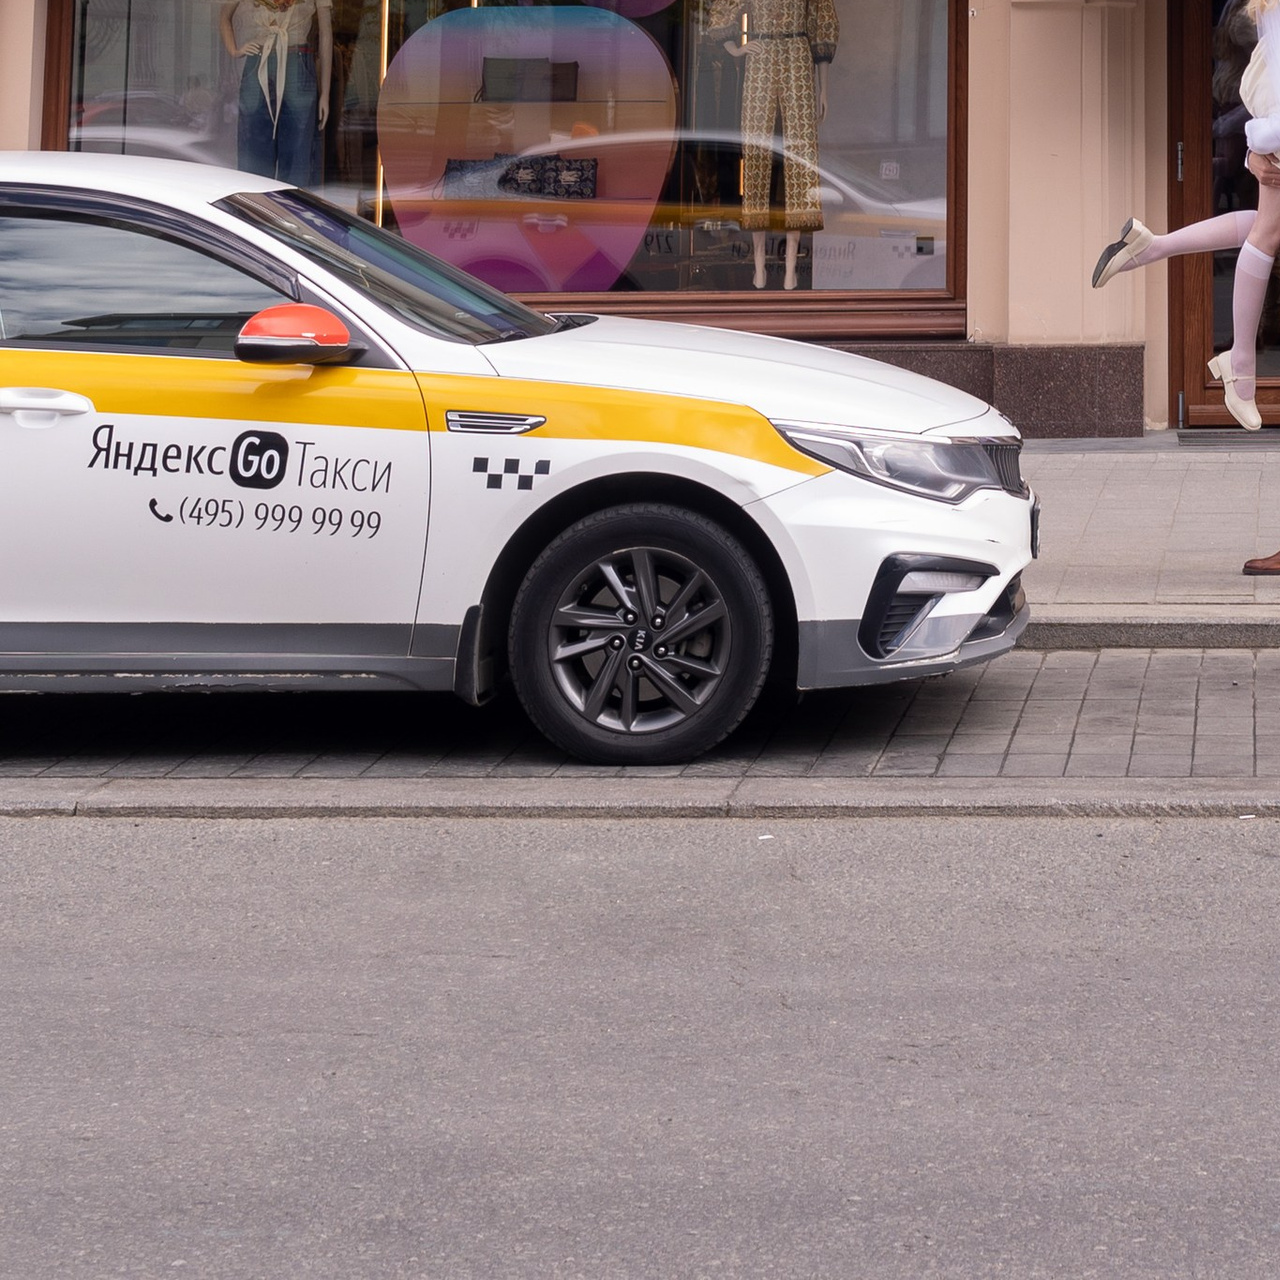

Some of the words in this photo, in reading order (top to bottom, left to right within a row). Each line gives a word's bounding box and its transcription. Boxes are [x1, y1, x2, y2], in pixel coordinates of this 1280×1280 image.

[87, 424, 227, 477] Яндекс
[236, 436, 281, 480] Go
[295, 441, 393, 493] Такси
[179, 496, 245, 529] (495)
[254, 503, 303, 533] 999
[311, 507, 343, 536] 99
[349, 510, 382, 539] 99
[634, 630, 646, 650] KIA
